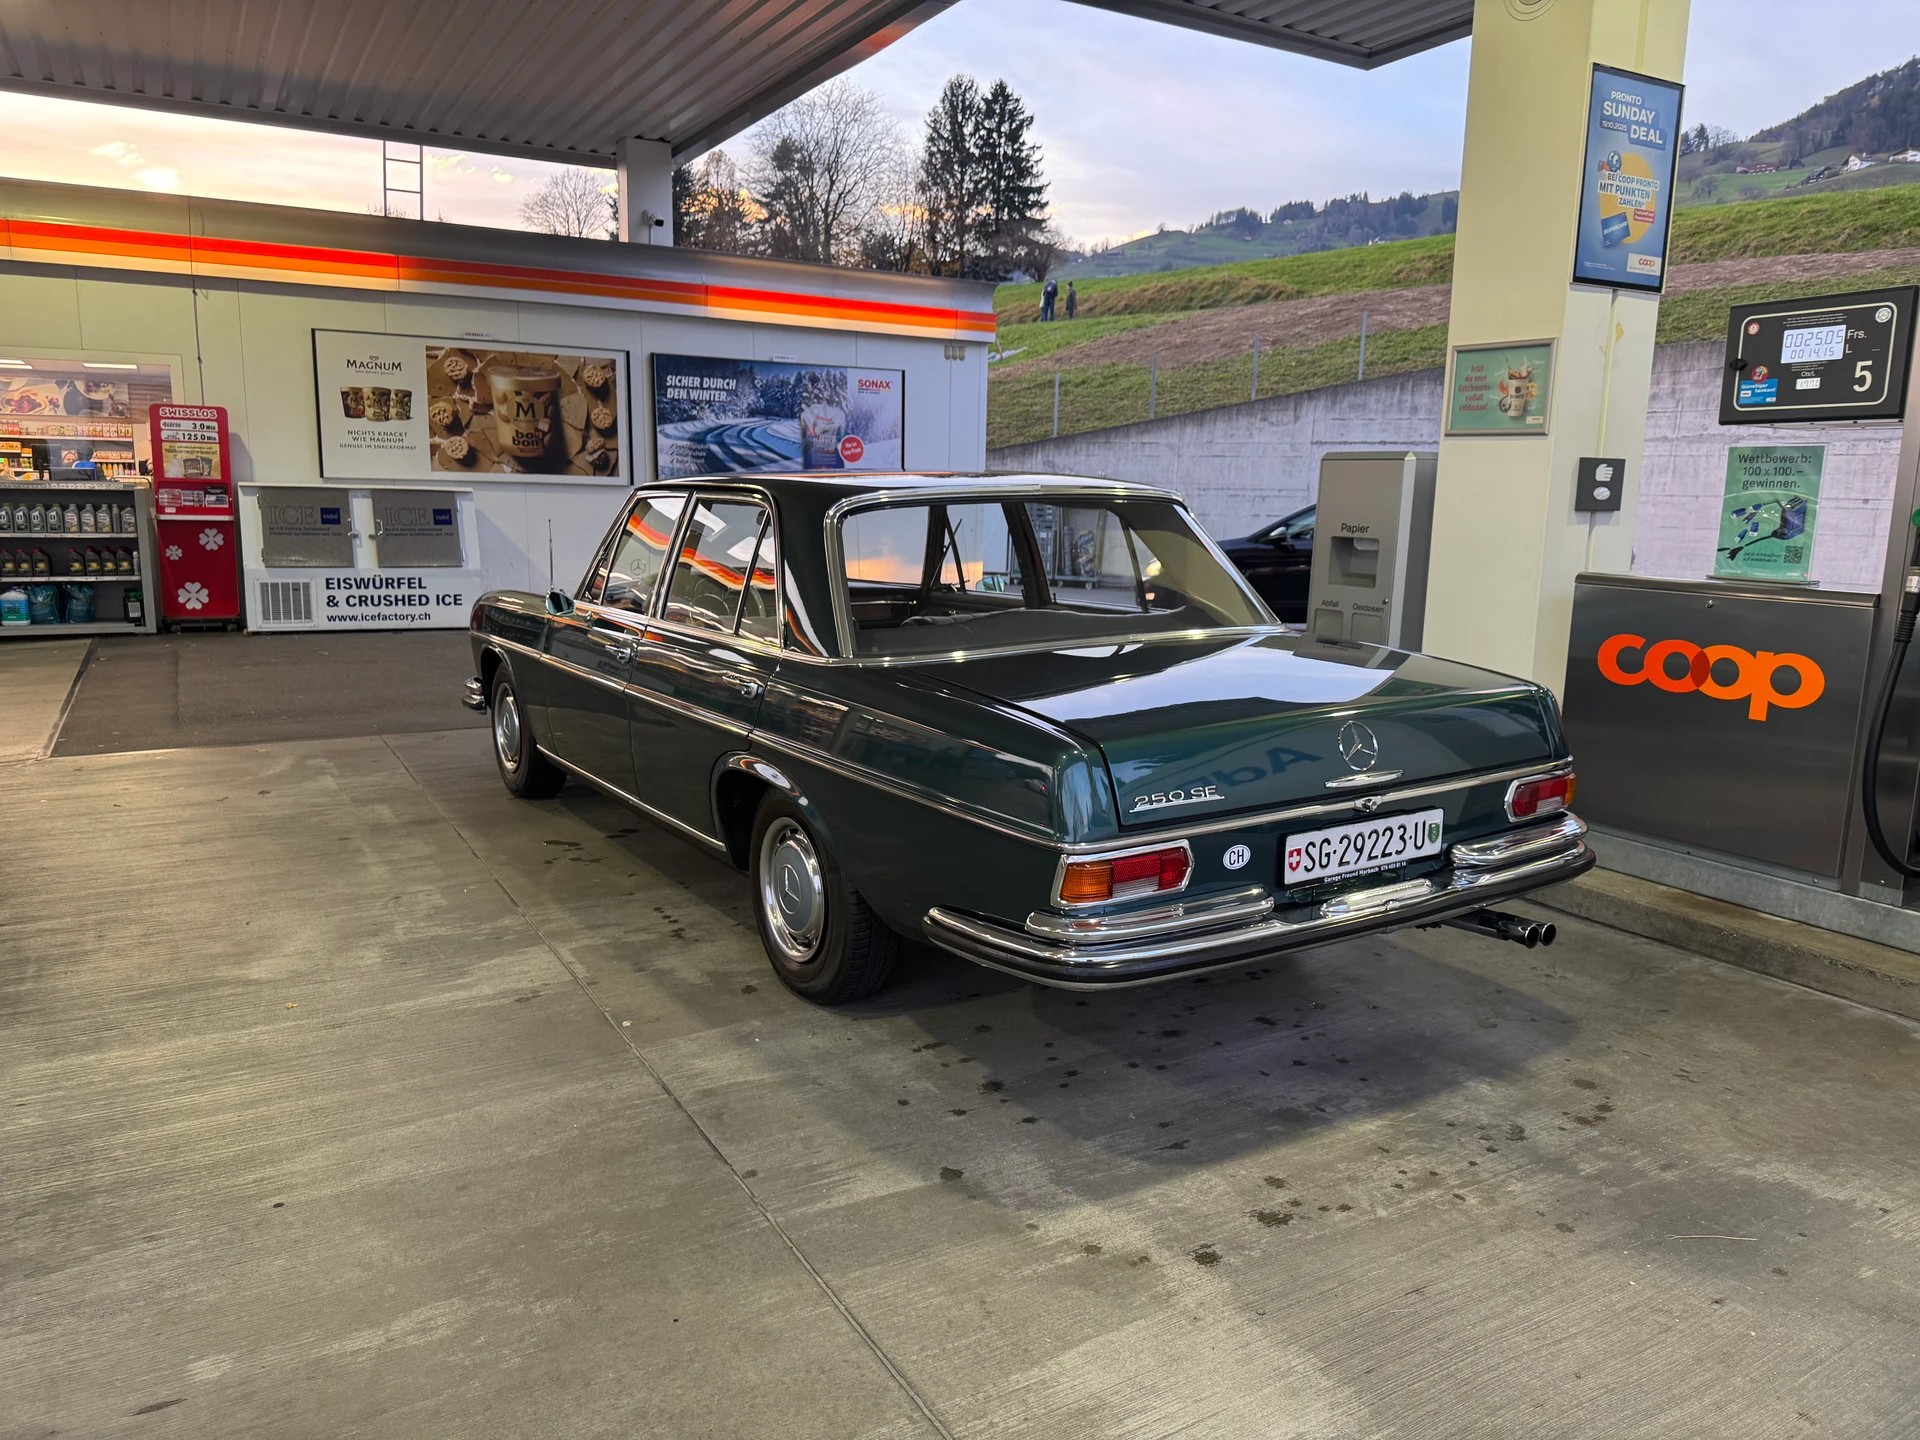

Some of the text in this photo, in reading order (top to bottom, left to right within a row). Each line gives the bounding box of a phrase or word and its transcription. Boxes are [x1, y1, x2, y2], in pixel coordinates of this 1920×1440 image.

[1611, 91, 1642, 105] PRONTO
[1603, 101, 1656, 124] SUNDAY
[1630, 124, 1663, 144] DEAL
[1607, 172, 1659, 190] BEI COOP PRONTO
[1599, 182, 1651, 200] MIT PUNKTEN
[1638, 258, 1656, 268] coop
[1846, 329, 1867, 340] Frs.
[1845, 344, 1853, 353] L
[346, 359, 402, 371] MAGNUM
[666, 375, 737, 390] SICHER DURCH
[1853, 360, 1873, 392] 5
[857, 379, 891, 390] SONAX
[666, 387, 728, 402] DEN WINTER
[160, 407, 217, 419] SWISSLOS
[515, 400, 537, 418] M
[347, 429, 376, 437] NICHTS
[1738, 453, 1812, 464] Wettbewerb:
[1743, 467, 1761, 476] 100
[1741, 478, 1801, 490] gewinnen.
[268, 505, 317, 526] ICE
[384, 507, 430, 526] ICE
[1341, 523, 1370, 534] Papier
[325, 575, 427, 590] EISWÜRFEL
[326, 594, 463, 608] & CRUSHED ICE
[1321, 599, 1339, 608] Abfall
[1352, 603, 1385, 613] Oeldosen
[326, 612, 431, 623] www.icefactory.ch
[1597, 633, 1825, 722] coop
[1134, 789, 1185, 807] 250
[1228, 847, 1245, 866] CH
[1323, 875, 1341, 884] Garage
[1341, 870, 1359, 880] Freund
[1359, 867, 1379, 876] Marbach
